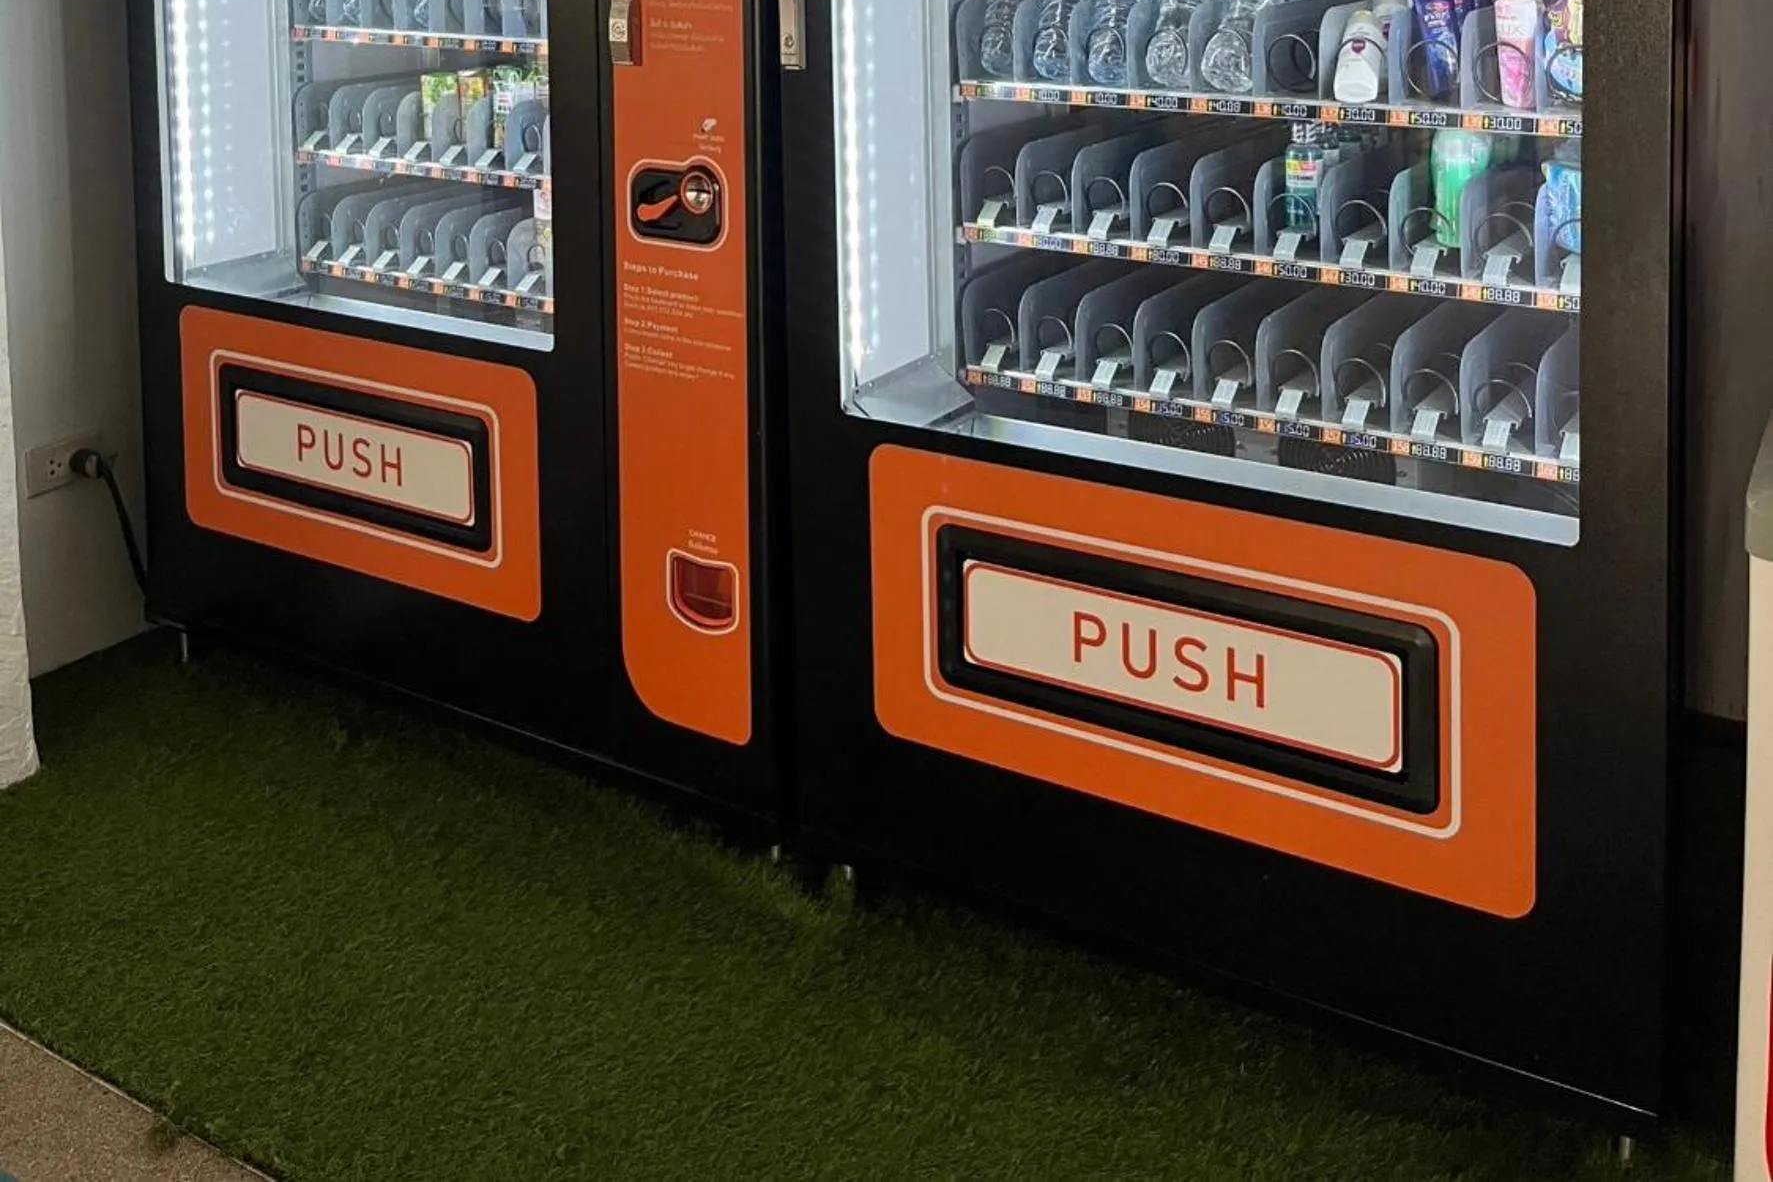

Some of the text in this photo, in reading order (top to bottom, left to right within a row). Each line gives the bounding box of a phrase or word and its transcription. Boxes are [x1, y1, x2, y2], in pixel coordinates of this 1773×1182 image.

[1489, 117, 1522, 131] 30.00
[1487, 287, 1520, 303] 88.88
[297, 423, 403, 487] PUSH
[1488, 455, 1521, 471] 88.88
[1072, 610, 1266, 709] PUSH
